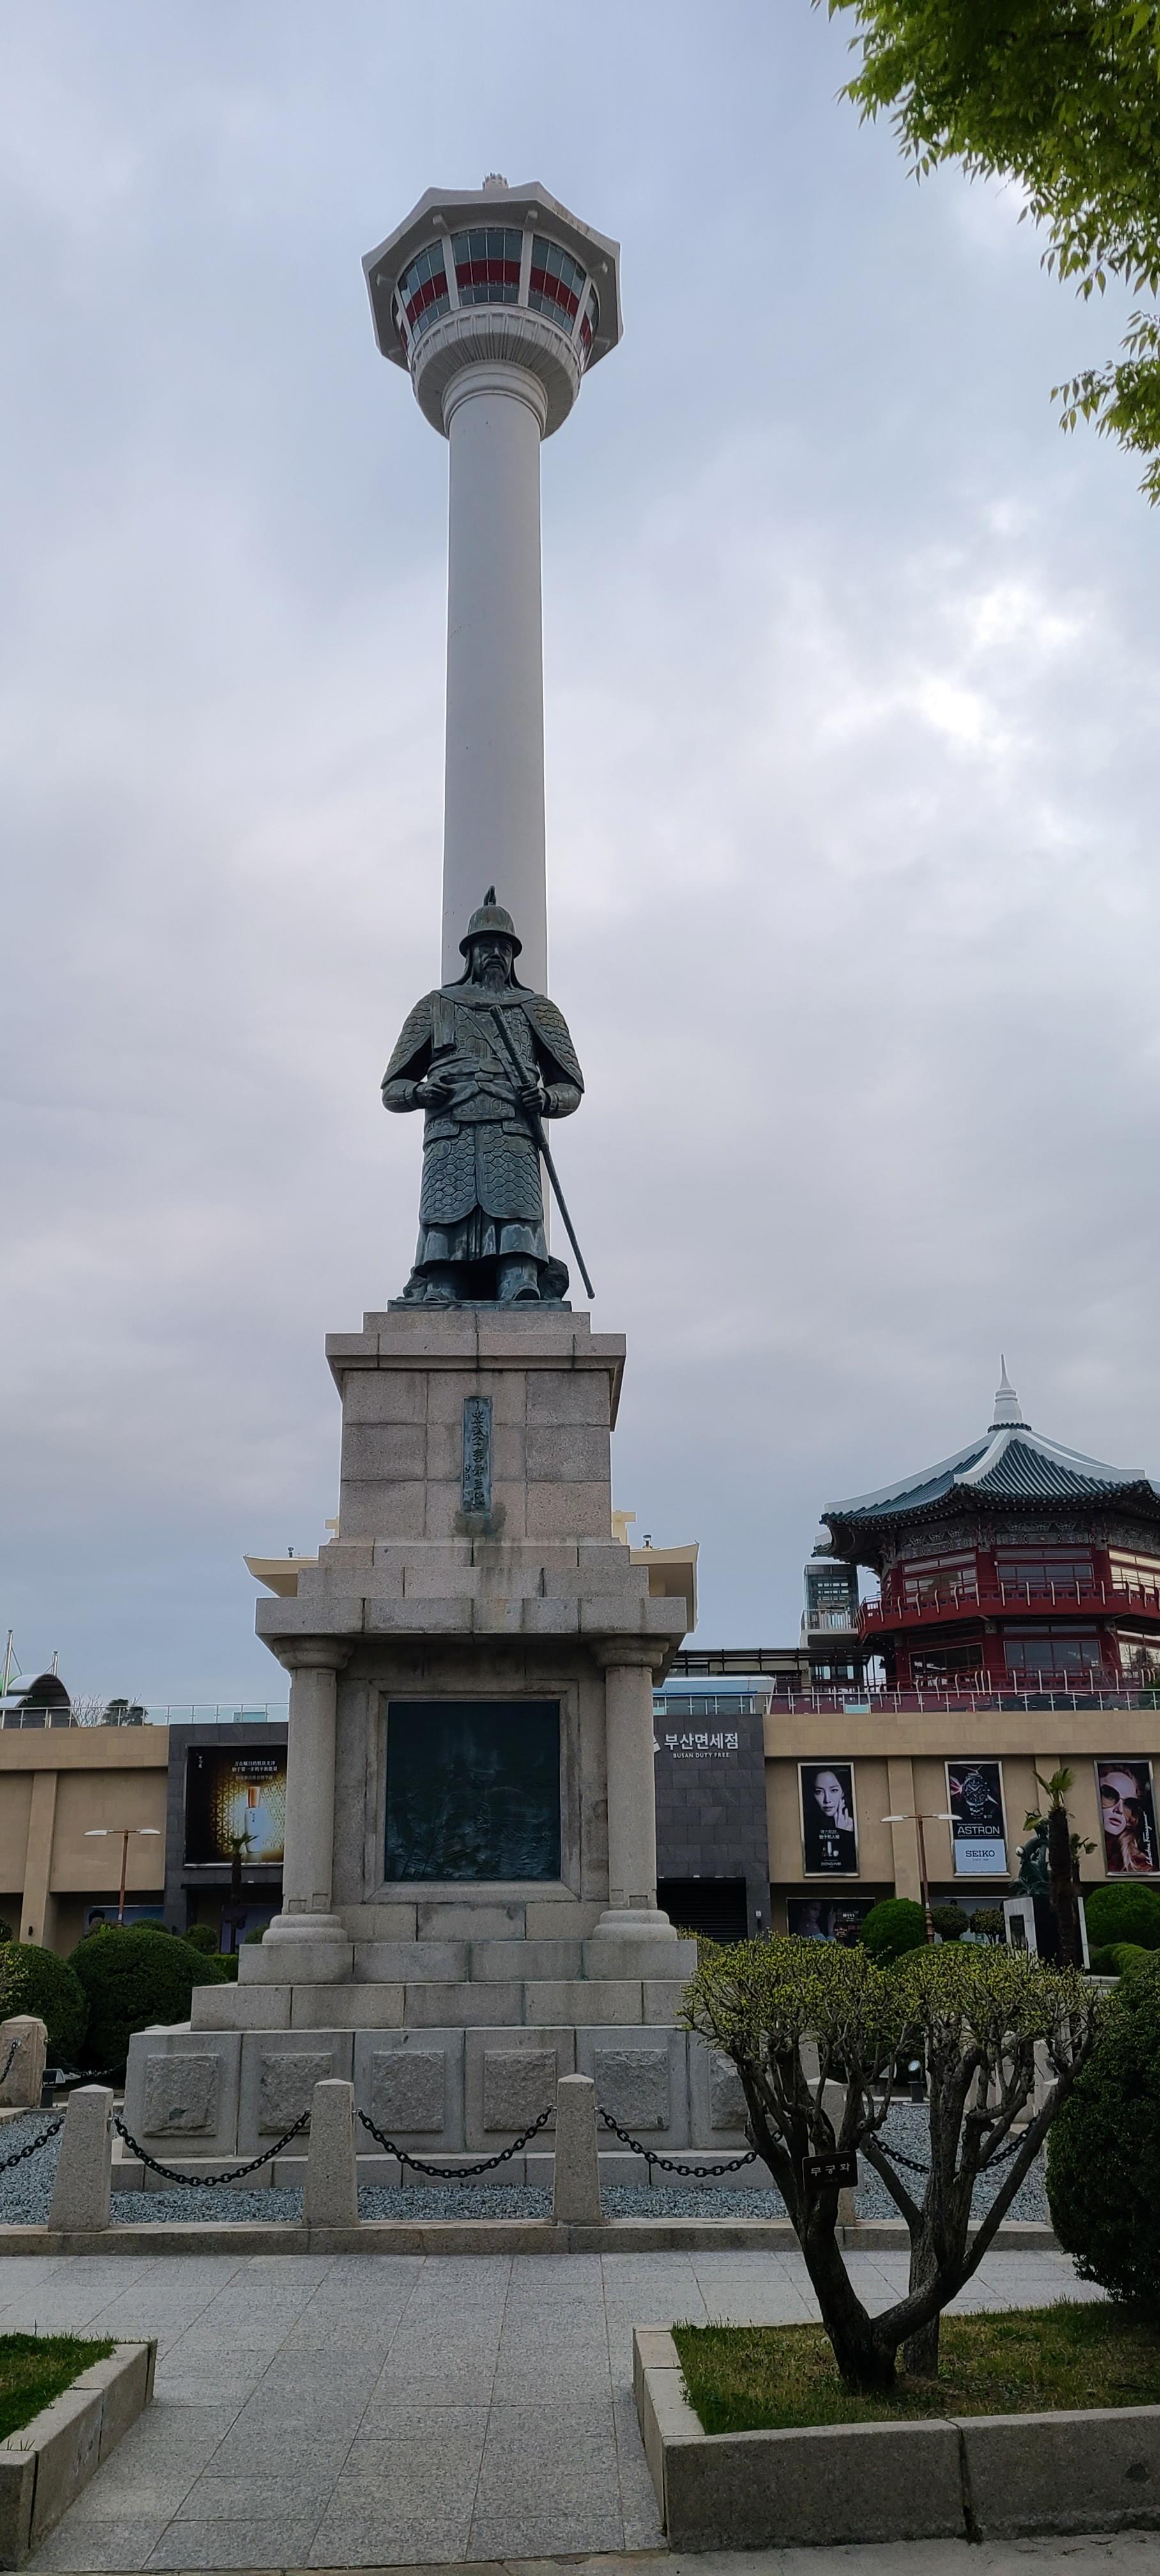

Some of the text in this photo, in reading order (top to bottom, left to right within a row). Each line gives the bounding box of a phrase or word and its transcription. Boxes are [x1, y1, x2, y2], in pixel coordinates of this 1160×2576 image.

[664, 1732, 739, 1751] 부산면세점
[957, 1826, 1001, 1835] ASTRON
[810, 2162, 850, 2177] 무궁화
